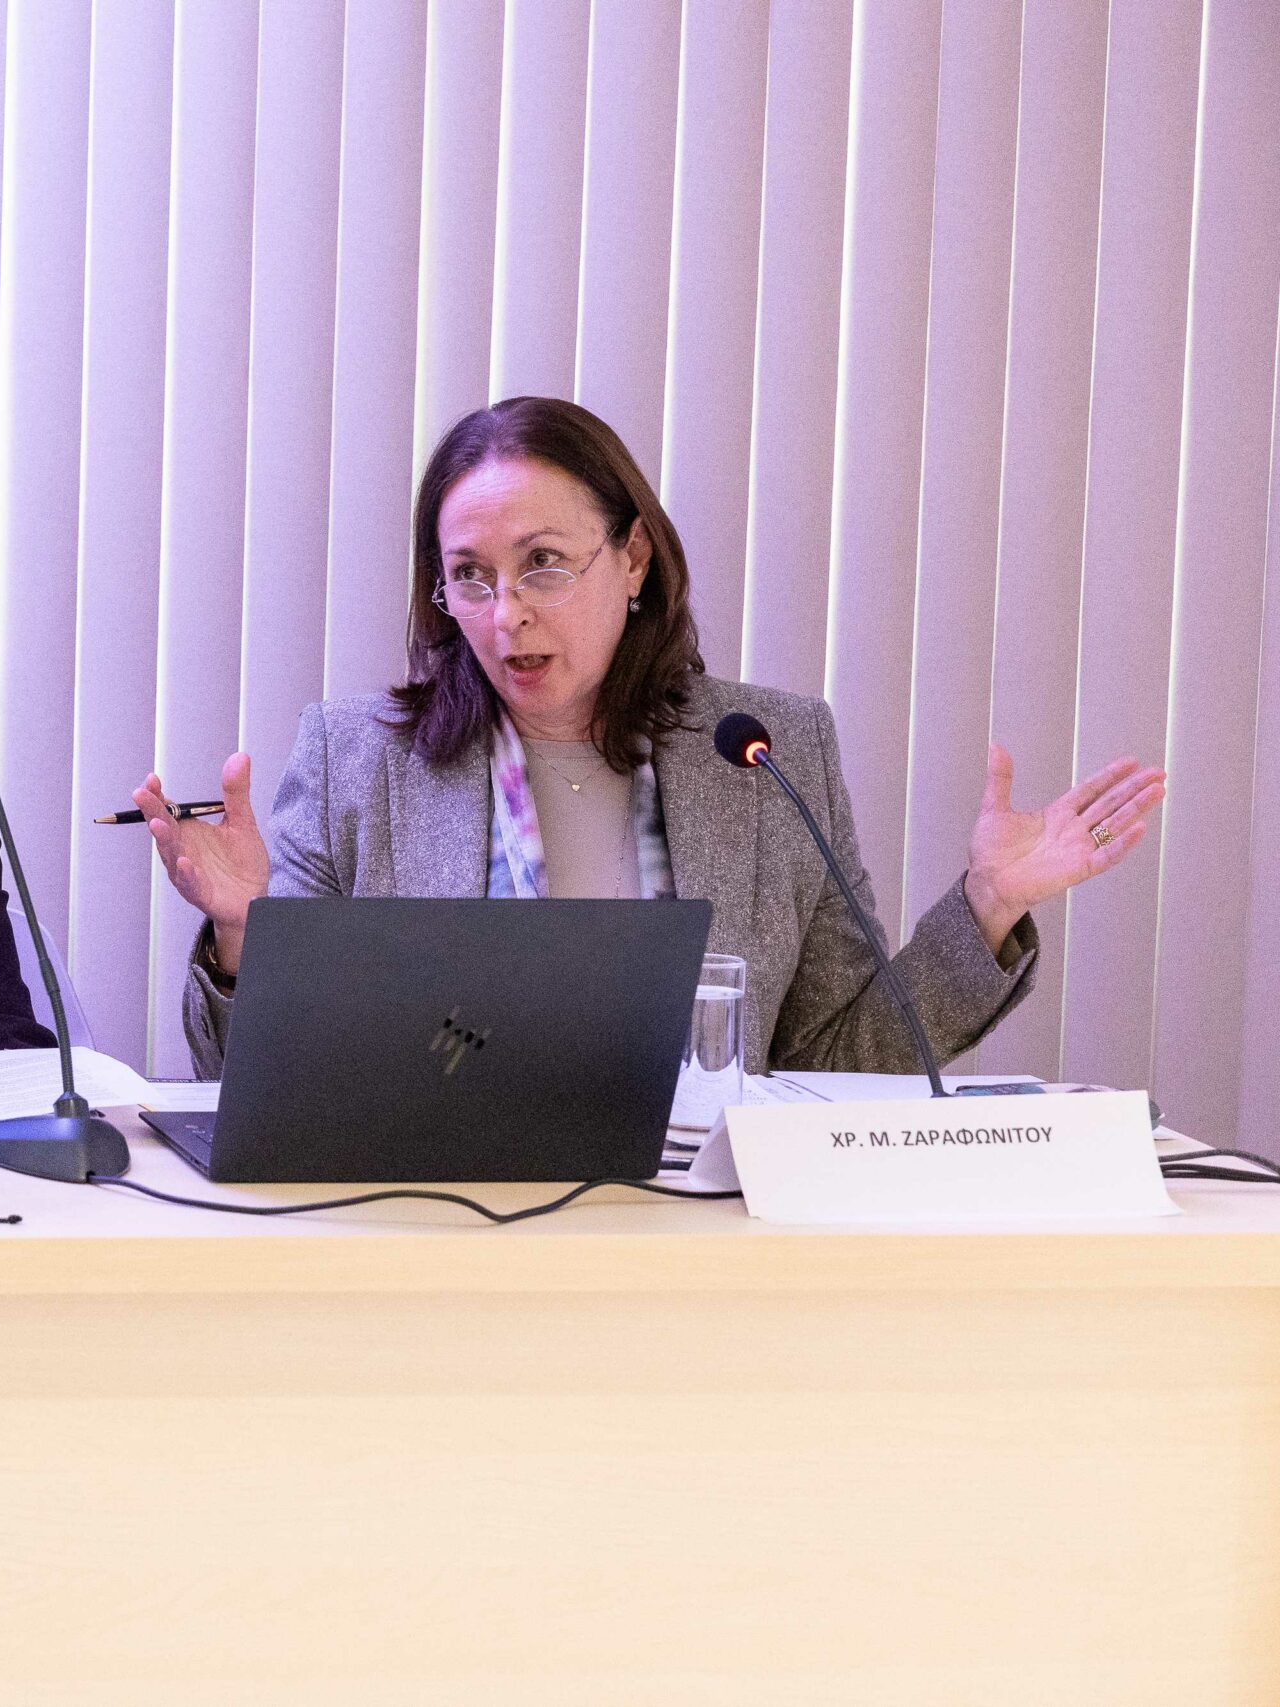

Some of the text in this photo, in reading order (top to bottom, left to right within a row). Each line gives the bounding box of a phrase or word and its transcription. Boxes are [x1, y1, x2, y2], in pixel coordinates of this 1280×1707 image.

[831, 1126, 1053, 1148] ΧΡ. Μ. ΖΑΡΑΦΩΝΙΤΟΥ
